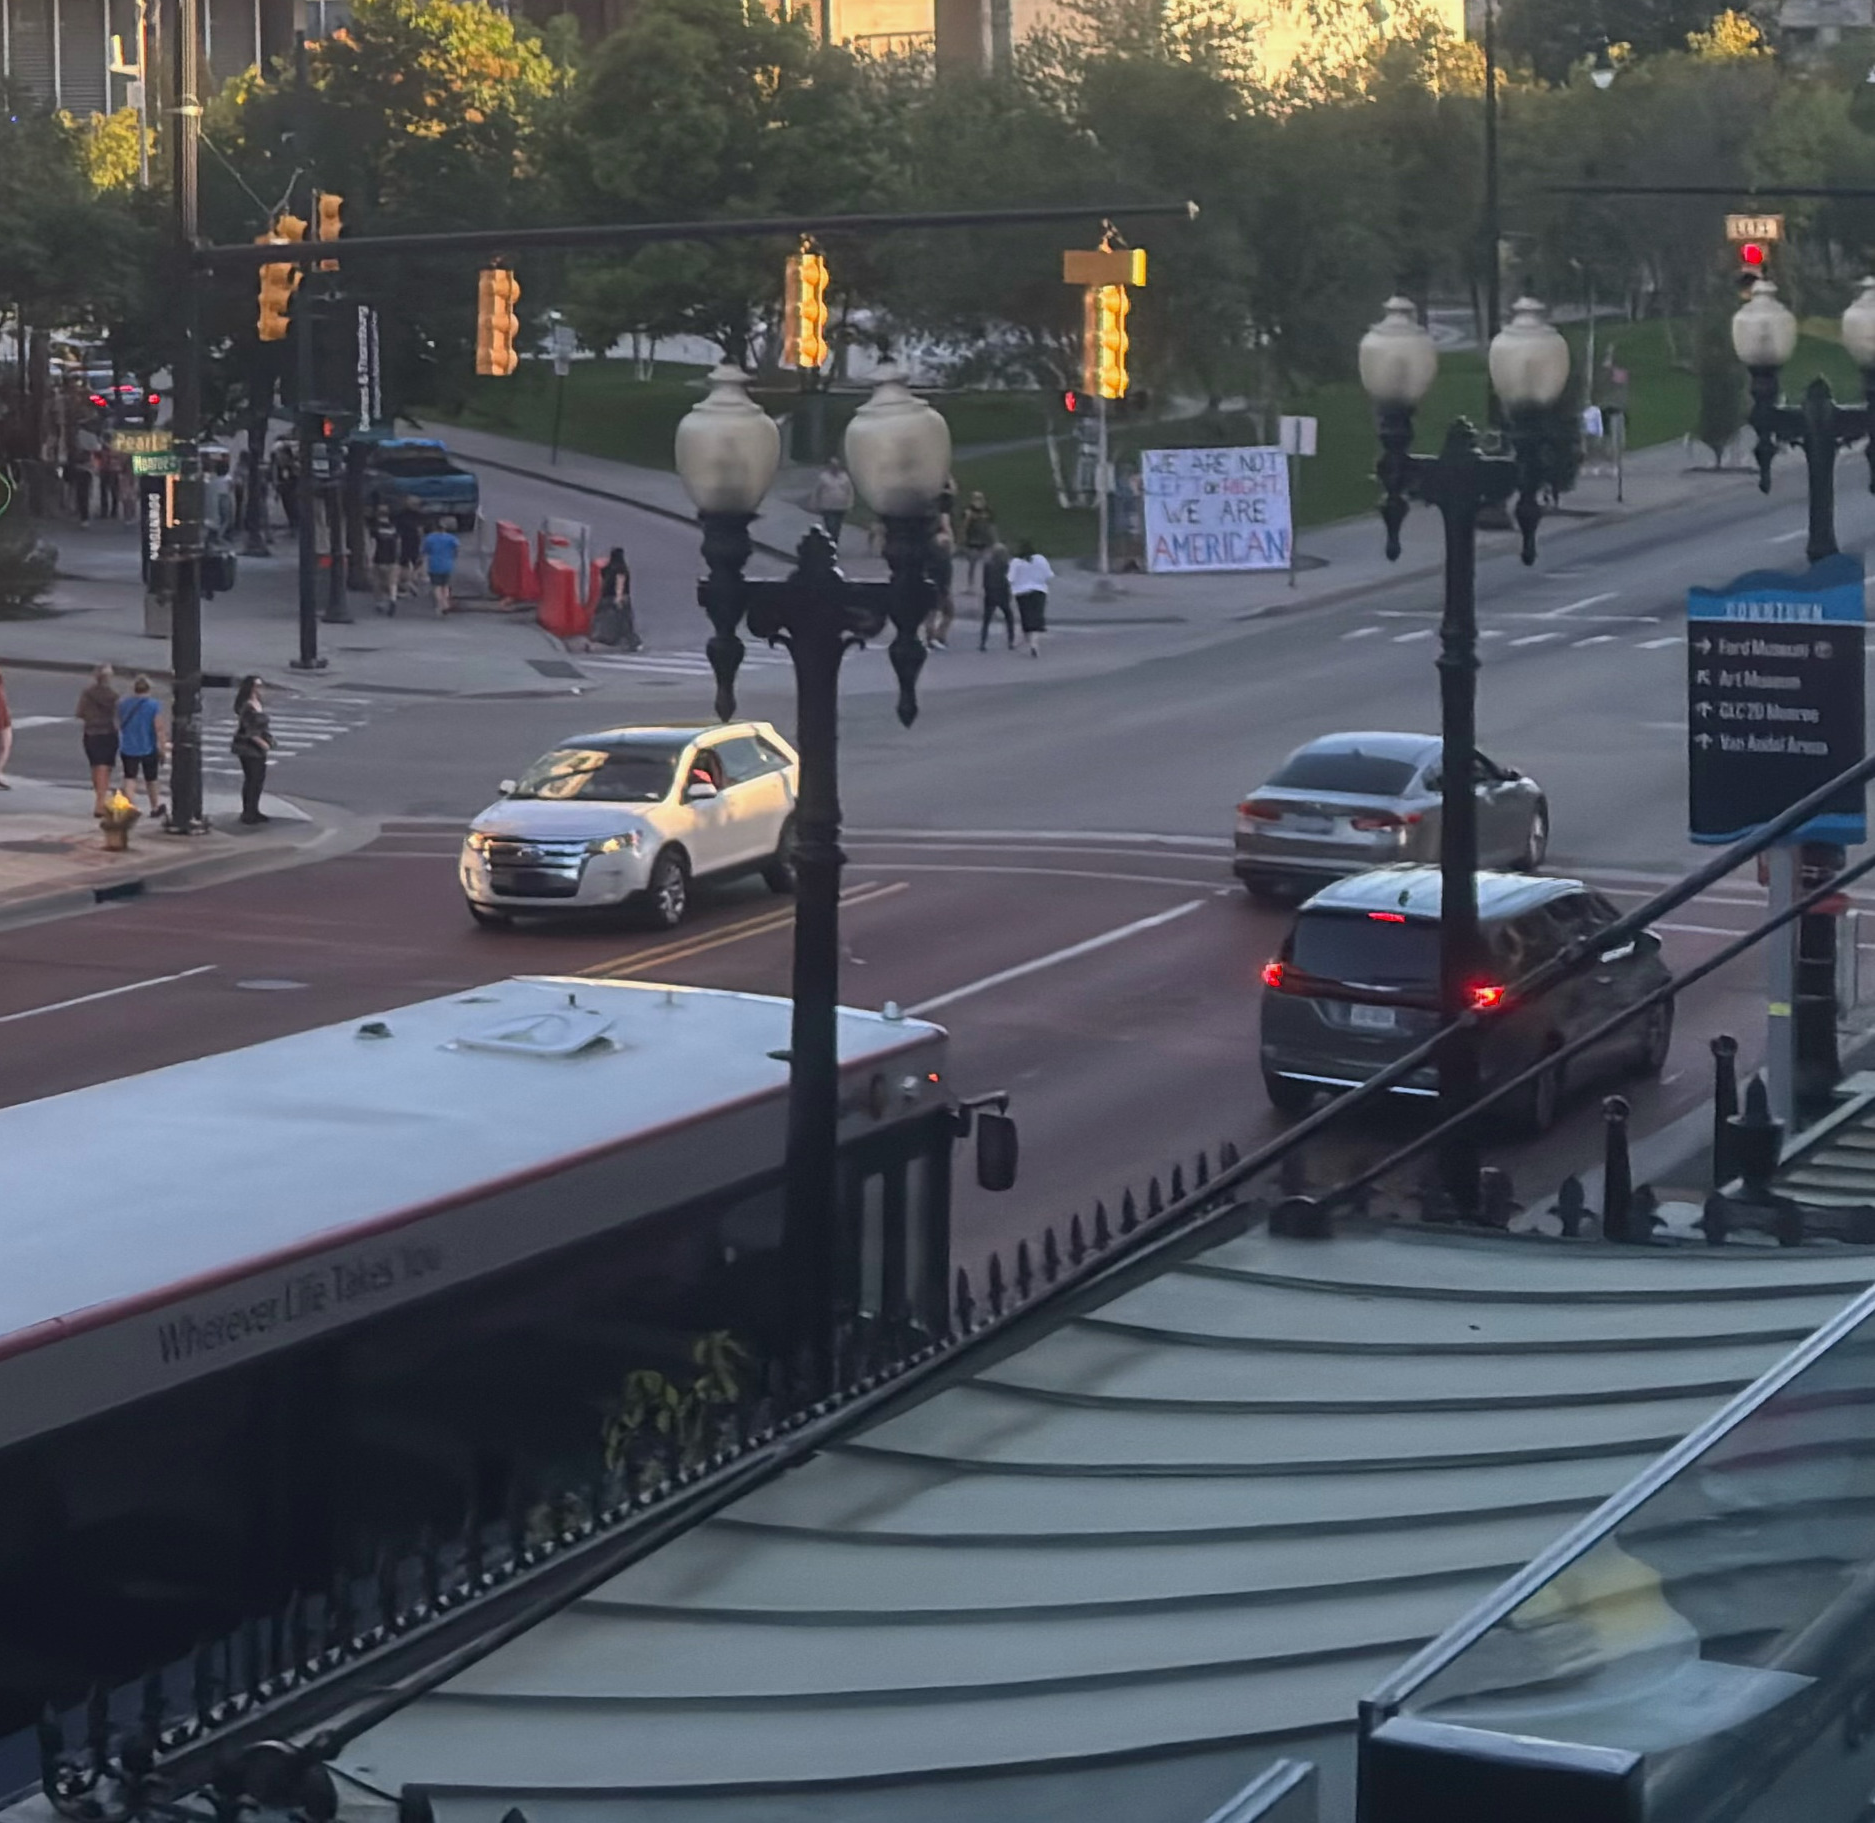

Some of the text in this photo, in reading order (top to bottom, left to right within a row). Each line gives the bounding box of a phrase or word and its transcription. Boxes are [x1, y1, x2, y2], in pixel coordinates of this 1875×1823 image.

[1144, 452, 1279, 475] WE ARE NOT
[1144, 476, 1202, 496] LEFT
[1161, 498, 1268, 524] WE ARE
[1725, 601, 1823, 621] DOWNTOWN
[158, 1295, 281, 1364] Wherever
